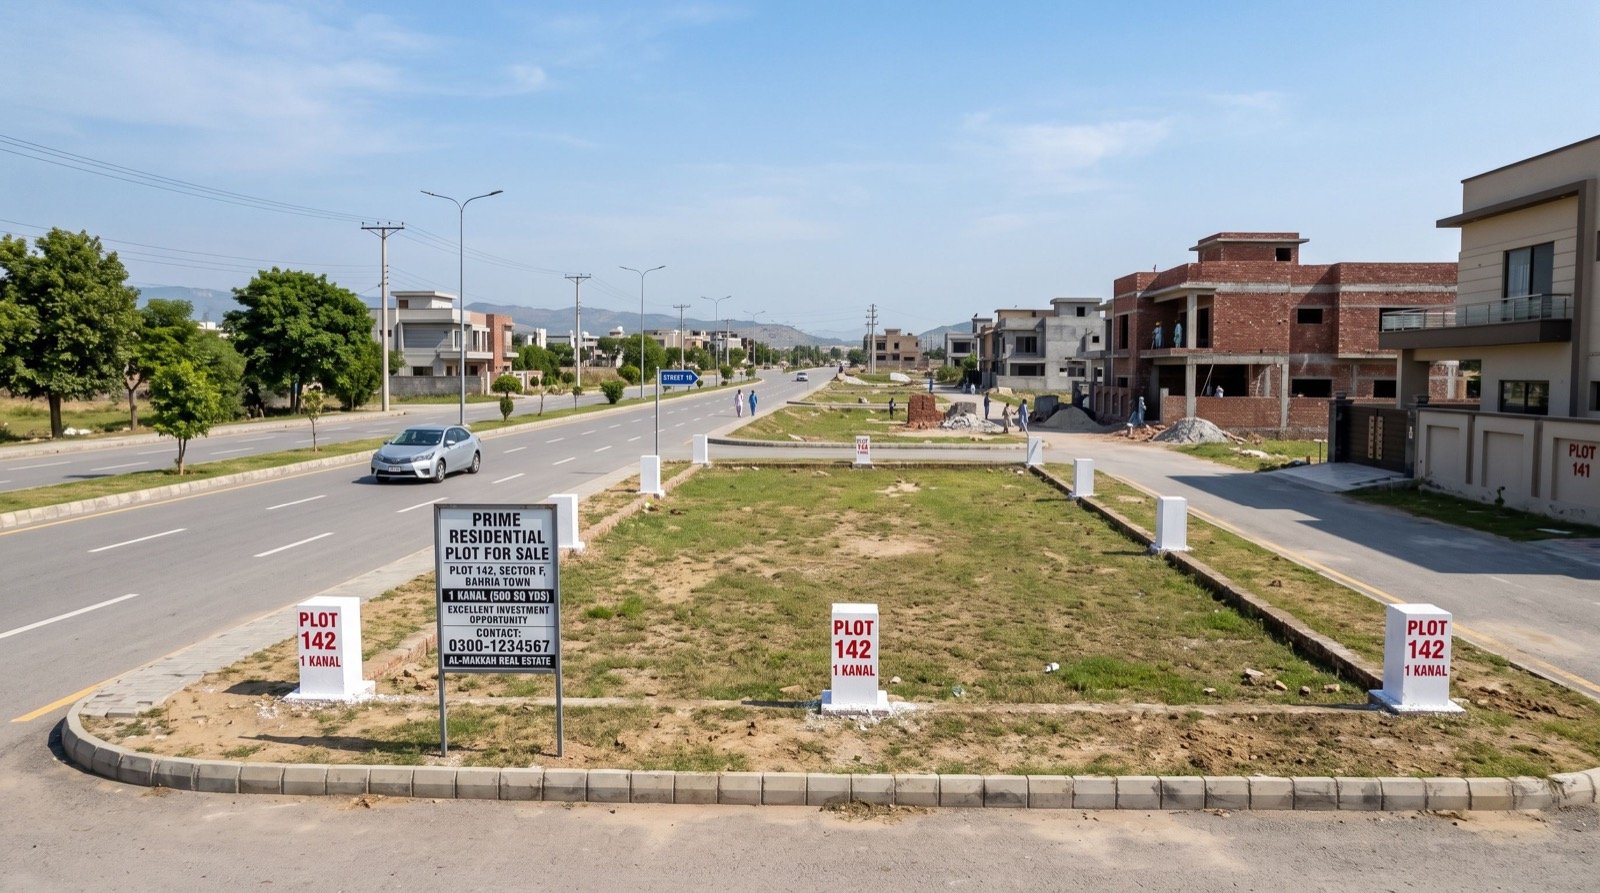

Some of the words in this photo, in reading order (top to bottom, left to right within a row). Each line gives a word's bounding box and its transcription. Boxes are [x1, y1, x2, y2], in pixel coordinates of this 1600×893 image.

[1569, 443, 1597, 460] PLOT
[1572, 461, 1590, 478] 141
[472, 512, 521, 527] PRIME
[449, 529, 545, 544] RESIDENTIAL
[445, 546, 479, 560] PLOT
[484, 547, 511, 560] FOR
[516, 547, 549, 560] SALE
[449, 566, 473, 575] PLOT
[476, 566, 497, 576] 142,
[499, 566, 536, 575] SECTOR
[539, 566, 546, 577] F,
[465, 577, 500, 586] BAHRIA
[503, 577, 531, 587] TOWN
[448, 591, 454, 600] 1
[457, 591, 487, 601] KANAL
[490, 591, 511, 602] (500
[513, 591, 526, 602] SQ
[528, 591, 550, 602] YDS)
[448, 605, 494, 614] EXCELLENT
[496, 605, 550, 615] INVESTMENT
[299, 611, 338, 628] PLOT
[469, 615, 528, 624] OPPORTUNITY
[476, 628, 521, 637] CONTACT:
[833, 620, 874, 636] PLOT
[1407, 620, 1448, 636] PLOT
[301, 631, 337, 650] 142
[449, 639, 550, 652] 0300-1234567
[835, 639, 871, 659] 142
[1408, 639, 1445, 659] 142
[300, 655, 305, 666] 1
[309, 655, 341, 667] KANAL
[448, 656, 497, 665] AL-MAKKAH
[499, 657, 519, 665] REAL
[521, 657, 551, 665] ESTATE
[833, 665, 838, 676] 1
[842, 664, 875, 676] KANAL
[1404, 665, 1410, 676] 1
[1414, 664, 1448, 676] KANAL
